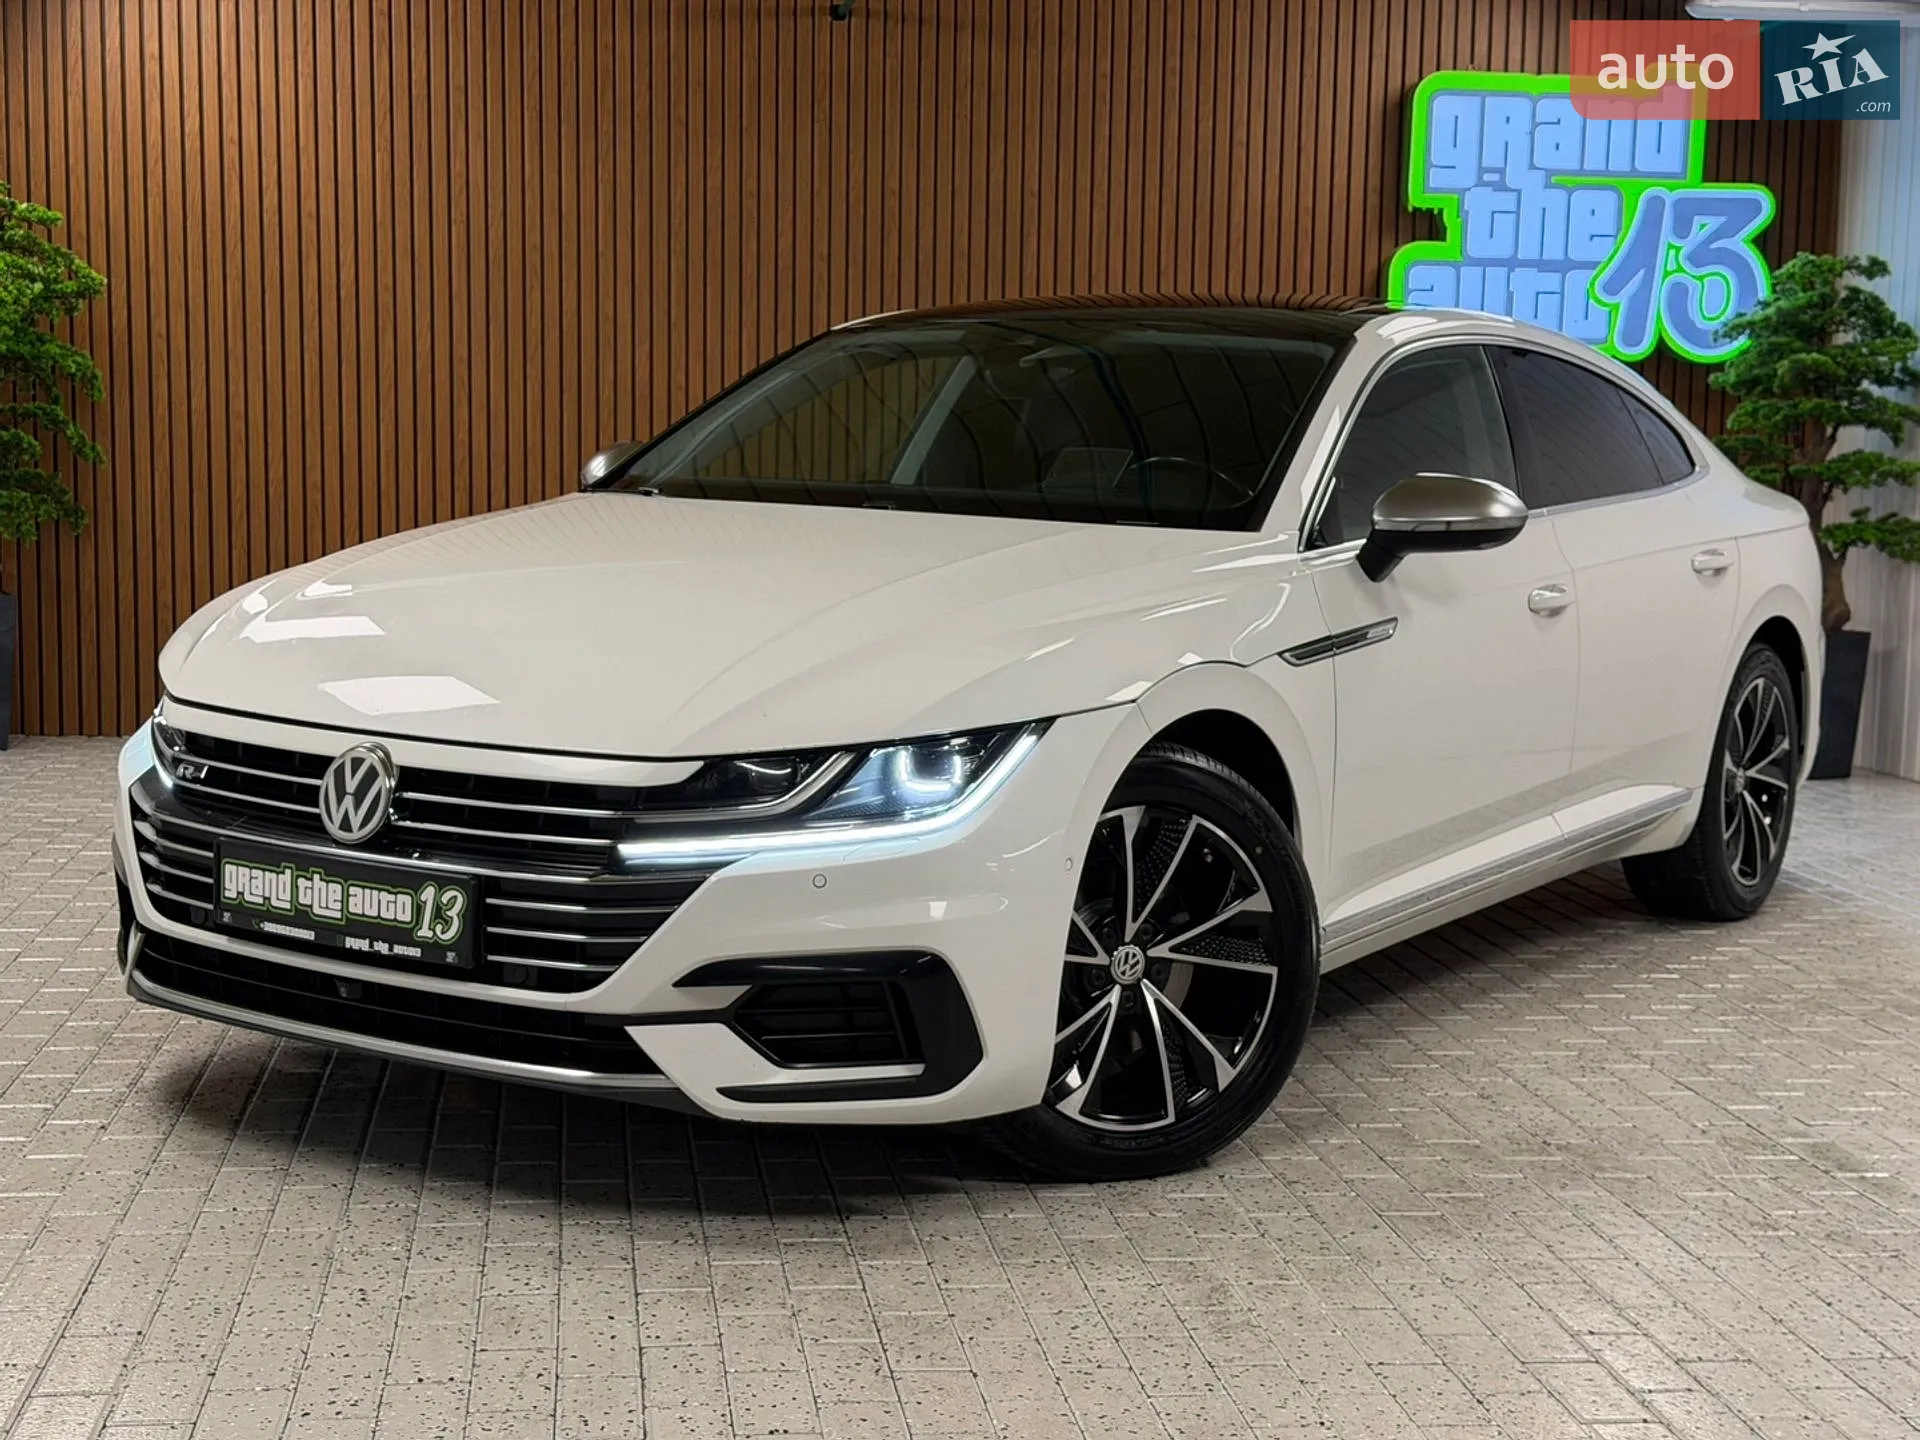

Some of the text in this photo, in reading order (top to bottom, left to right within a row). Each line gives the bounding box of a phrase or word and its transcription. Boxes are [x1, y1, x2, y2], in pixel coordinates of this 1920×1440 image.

[1430, 84, 1688, 189] grand
[1464, 169, 1620, 260] the
[1597, 190, 1766, 354] 13
[224, 863, 465, 941] grand the auto 13
